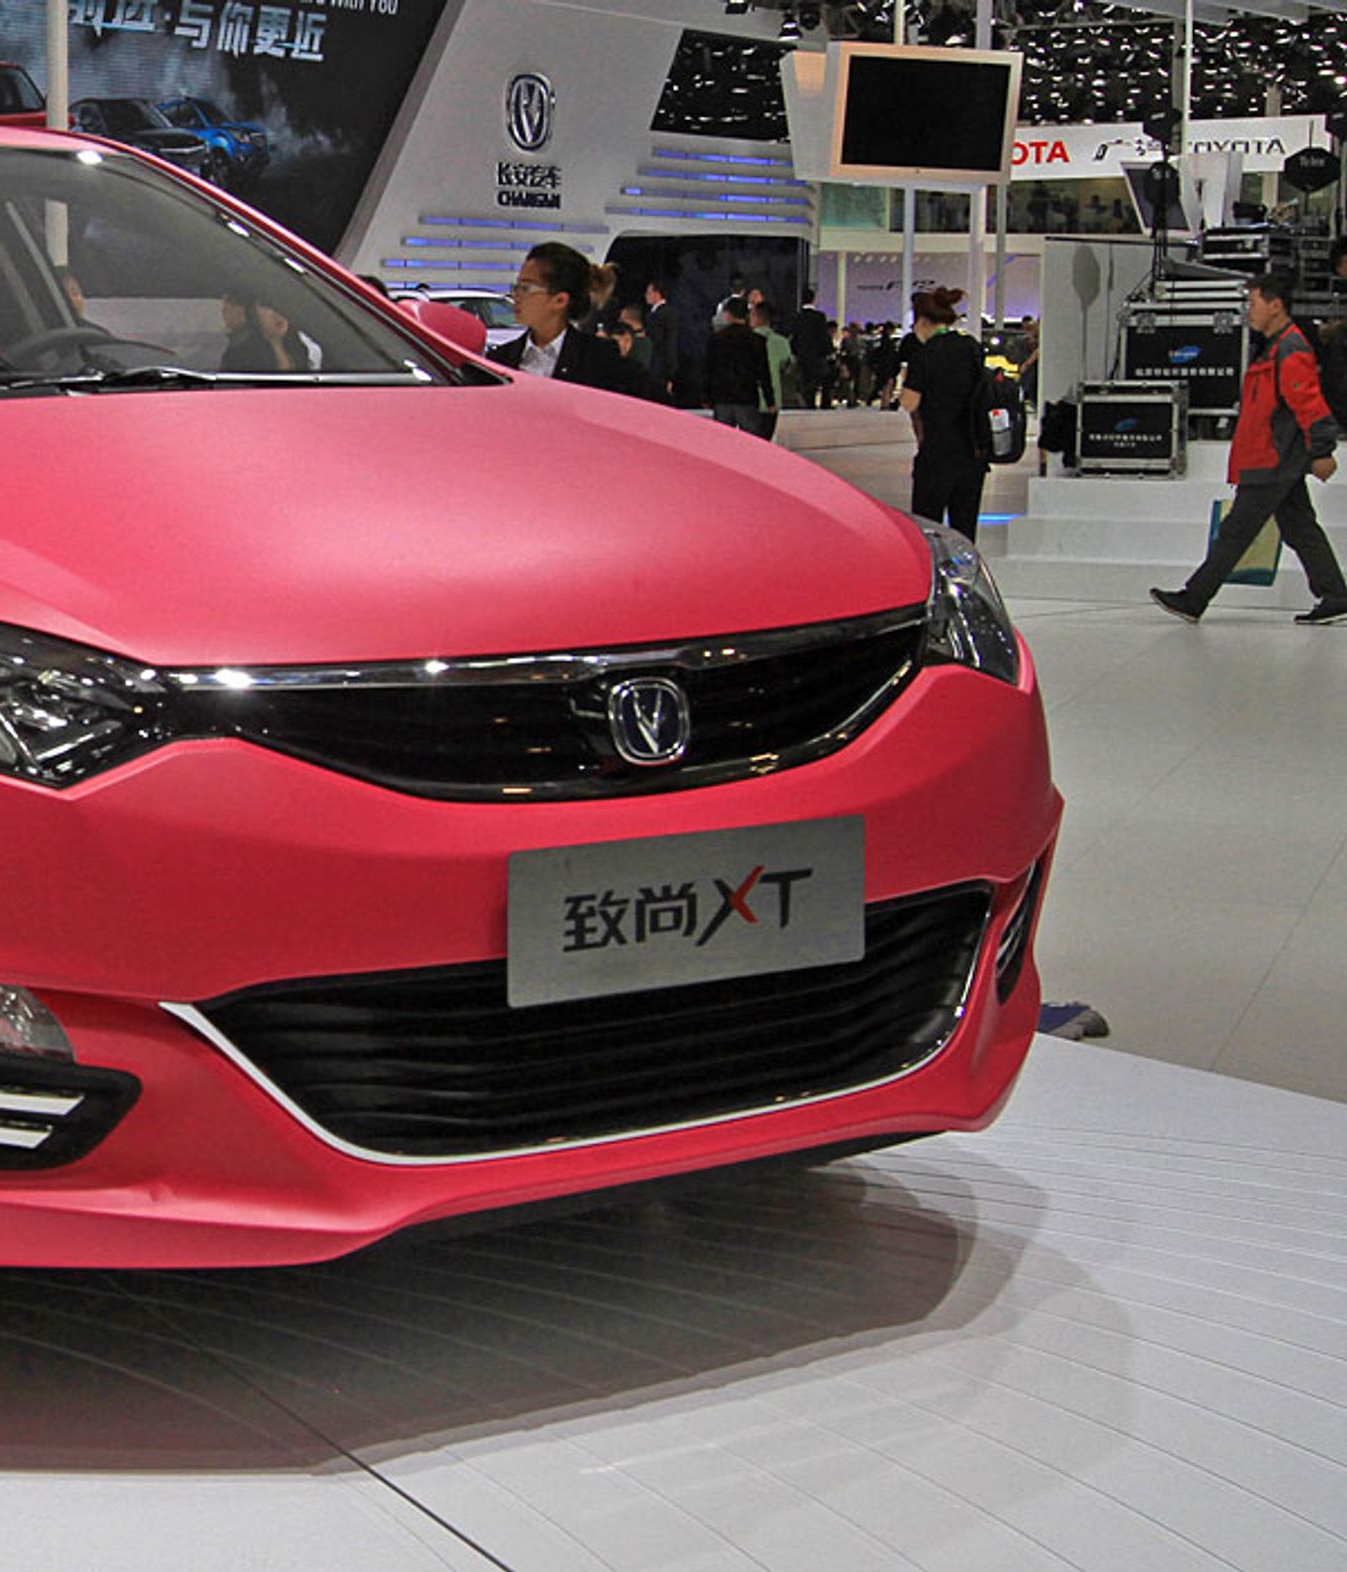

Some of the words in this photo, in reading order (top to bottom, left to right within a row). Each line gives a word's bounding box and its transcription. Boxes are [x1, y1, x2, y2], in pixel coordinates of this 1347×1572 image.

[1188, 139, 1286, 154] OYOTA
[498, 162, 562, 189] 长安汽车
